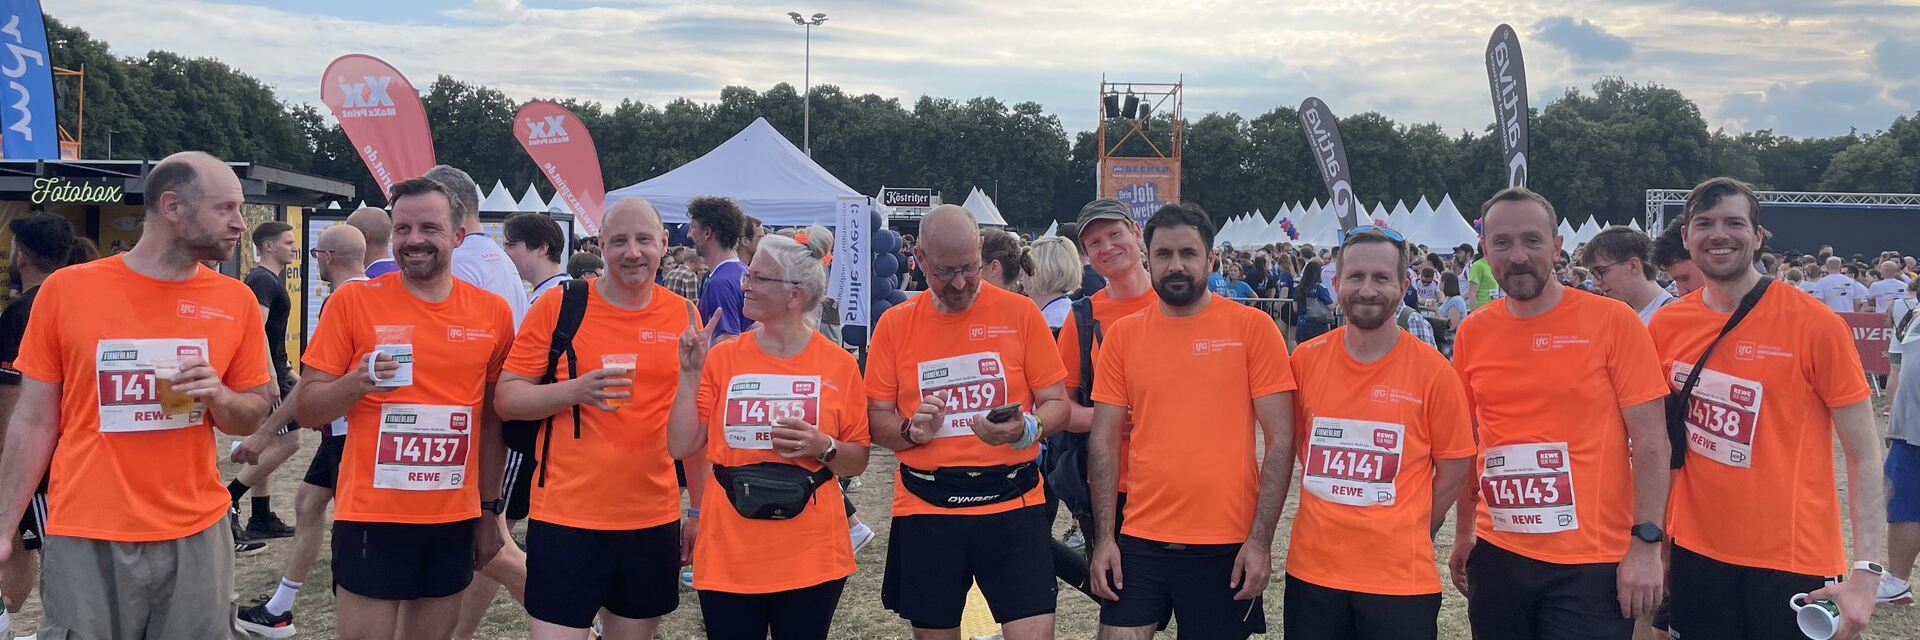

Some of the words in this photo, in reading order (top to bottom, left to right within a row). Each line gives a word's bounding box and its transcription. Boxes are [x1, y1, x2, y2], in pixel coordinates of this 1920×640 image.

[32, 177, 123, 204] Fotobox
[886, 191, 928, 204] Köstritzer
[1733, 387, 1752, 397] REWE
[738, 400, 805, 423] 14135
[1687, 397, 1741, 437] 14138
[951, 418, 974, 428] REW
[755, 432, 772, 441] RE
[1376, 432, 1394, 440] REWE
[1691, 432, 1717, 452] REWE
[393, 436, 460, 463] 14137
[1322, 449, 1384, 480] 14141
[408, 472, 441, 482] REWE
[1331, 485, 1364, 498] REWE
[1489, 477, 1559, 505] 14143
[1511, 515, 1543, 525] REWE
